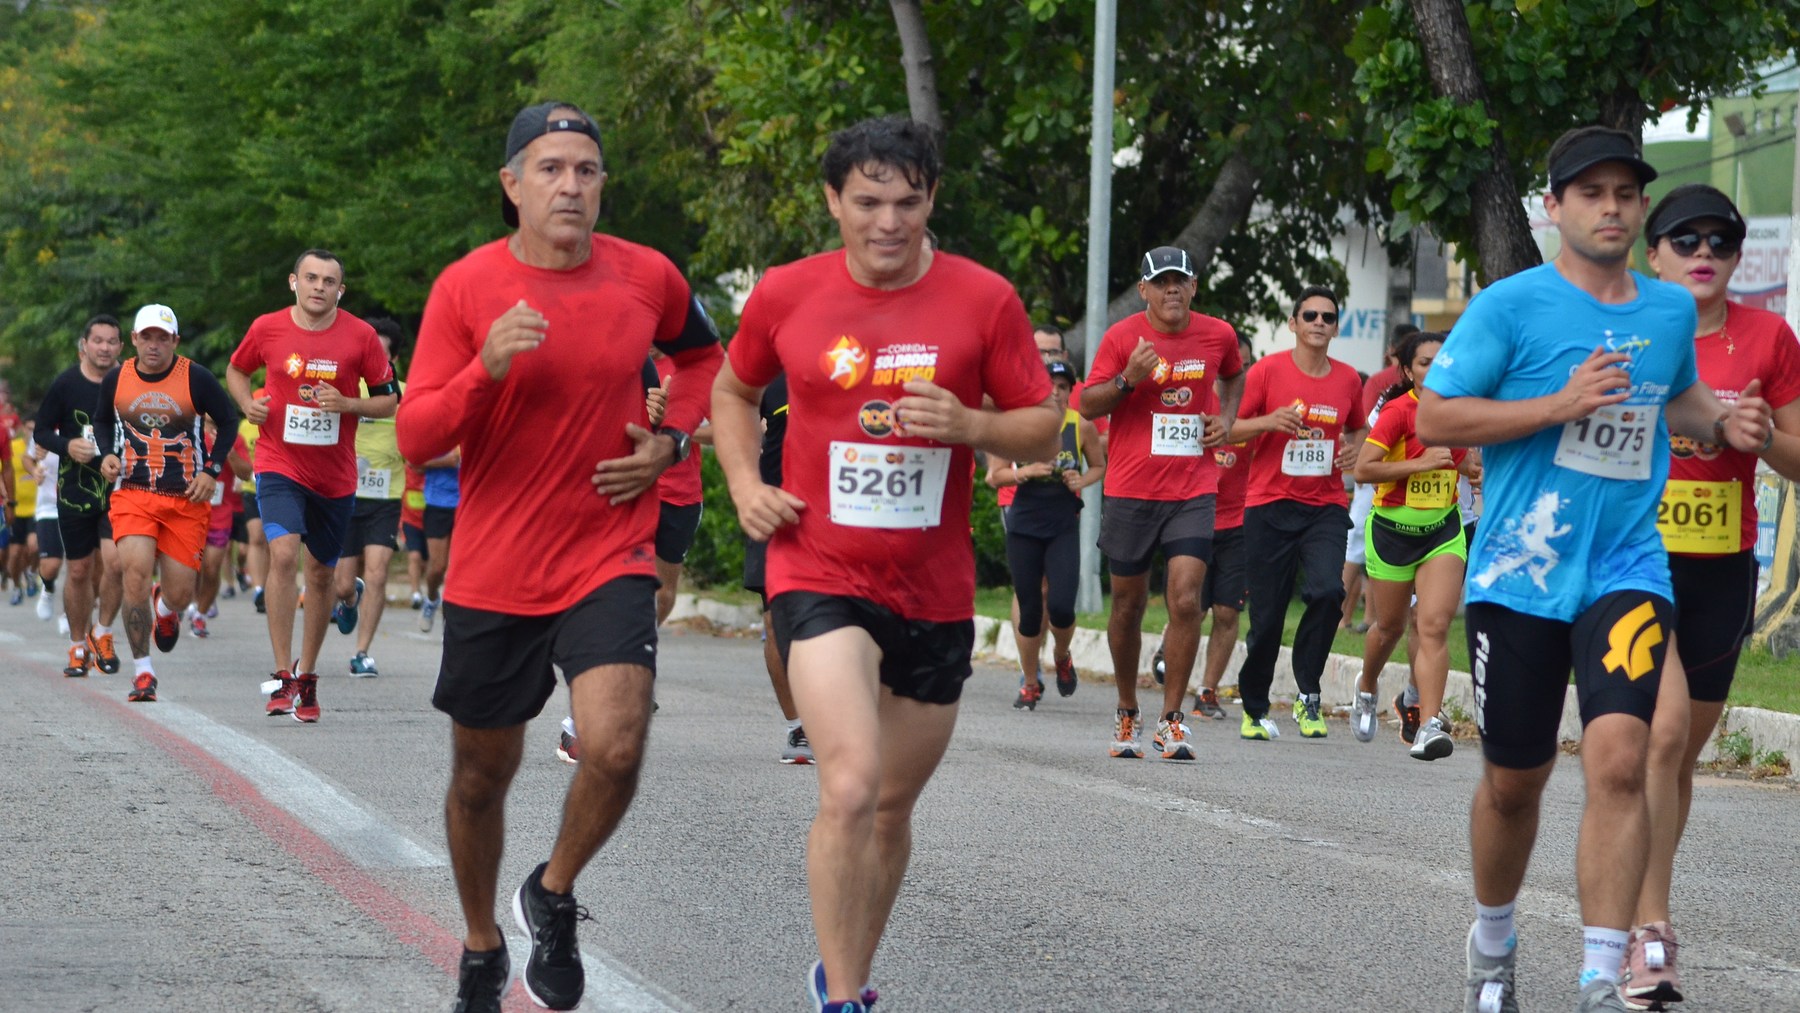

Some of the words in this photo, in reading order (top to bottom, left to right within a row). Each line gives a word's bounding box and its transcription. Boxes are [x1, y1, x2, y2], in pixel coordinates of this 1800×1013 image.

[887, 344, 927, 354] CORRIDA
[874, 353, 938, 370] SOLDADOS
[872, 369, 893, 385] DO
[1172, 371, 1184, 381] DO
[289, 416, 332, 431] 5423
[1157, 426, 1198, 441] 1294
[1574, 417, 1647, 452] 1075
[1287, 450, 1325, 462] 1188
[838, 466, 924, 497] 5261
[1410, 480, 1451, 494] 8011
[1656, 501, 1728, 527] 2061
[1395, 522, 1423, 534] DANIEL
